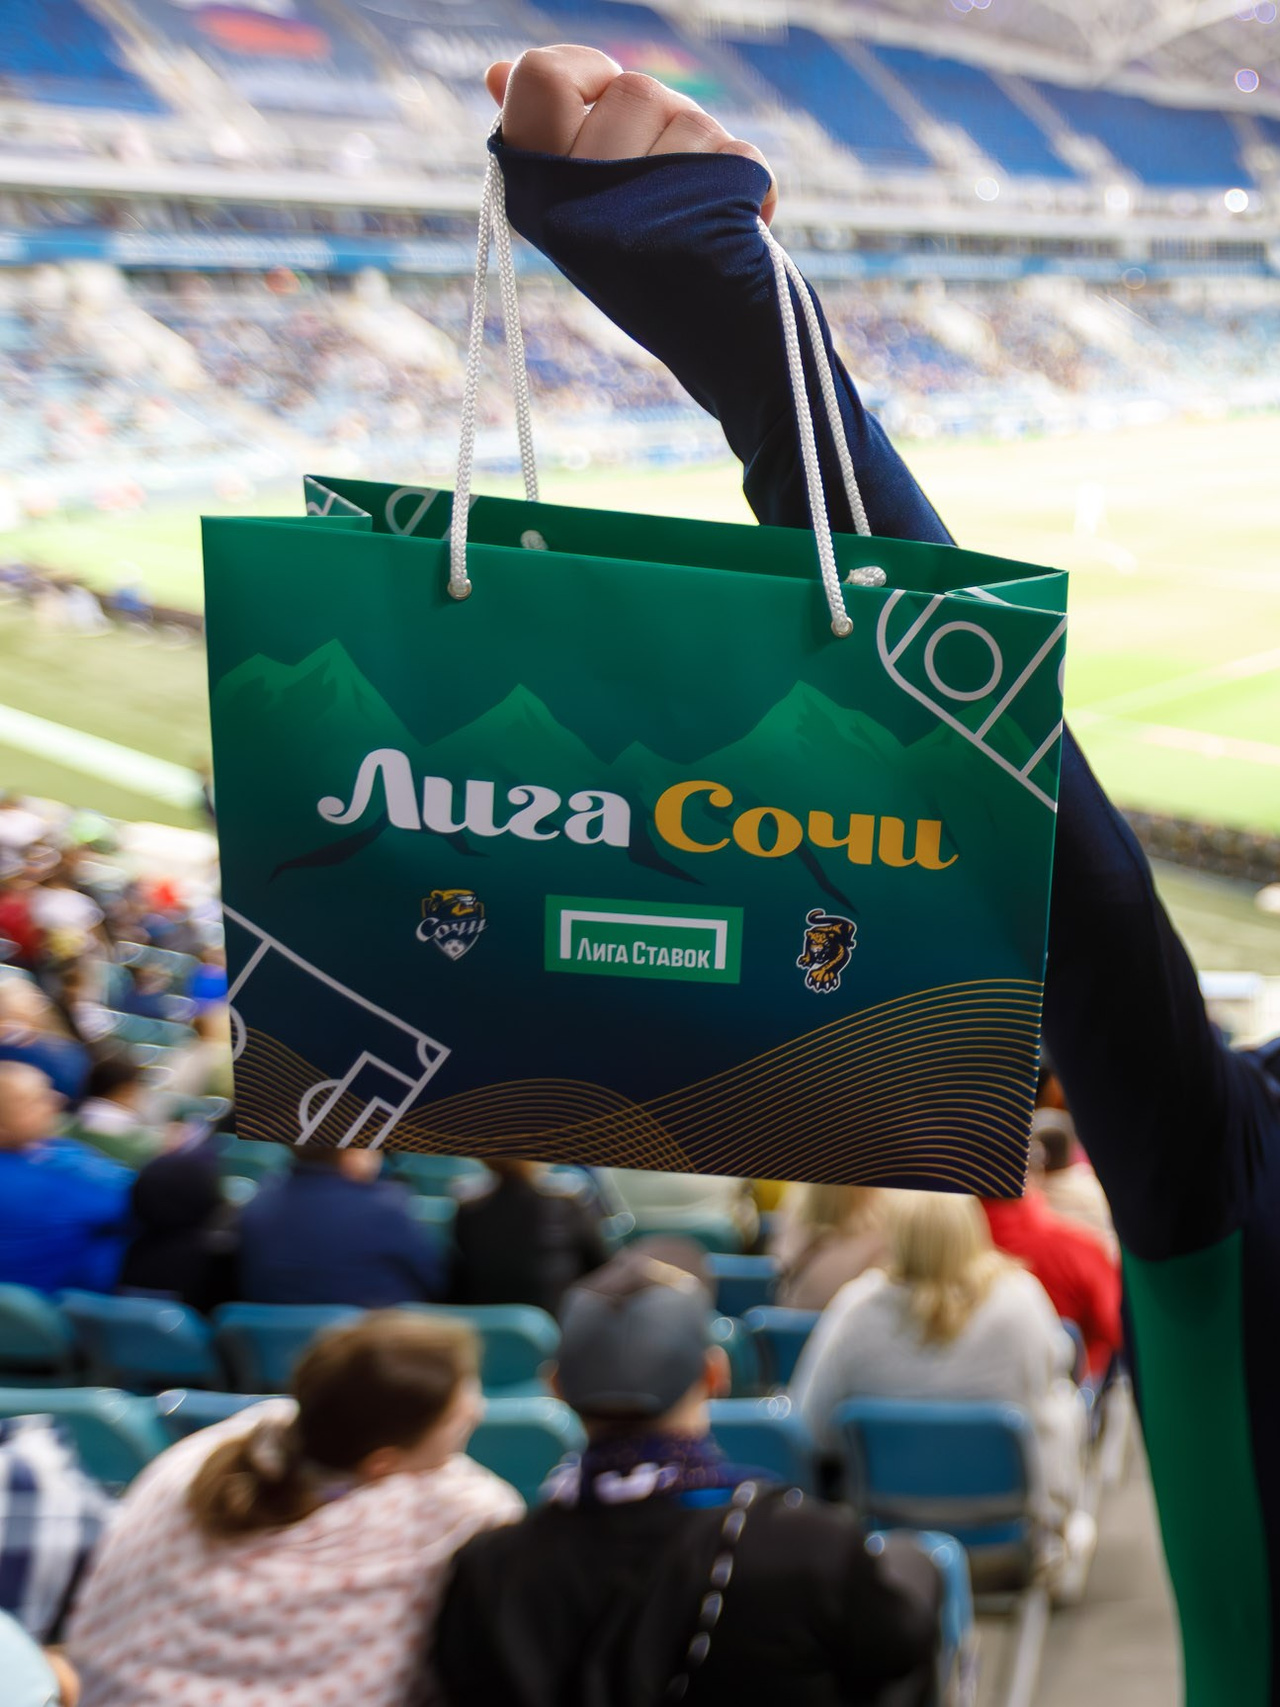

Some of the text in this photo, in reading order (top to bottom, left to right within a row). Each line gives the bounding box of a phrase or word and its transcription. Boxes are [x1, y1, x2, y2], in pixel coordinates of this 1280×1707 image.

[317, 748, 960, 870] Лига Сочи
[416, 917, 488, 942] Сочи
